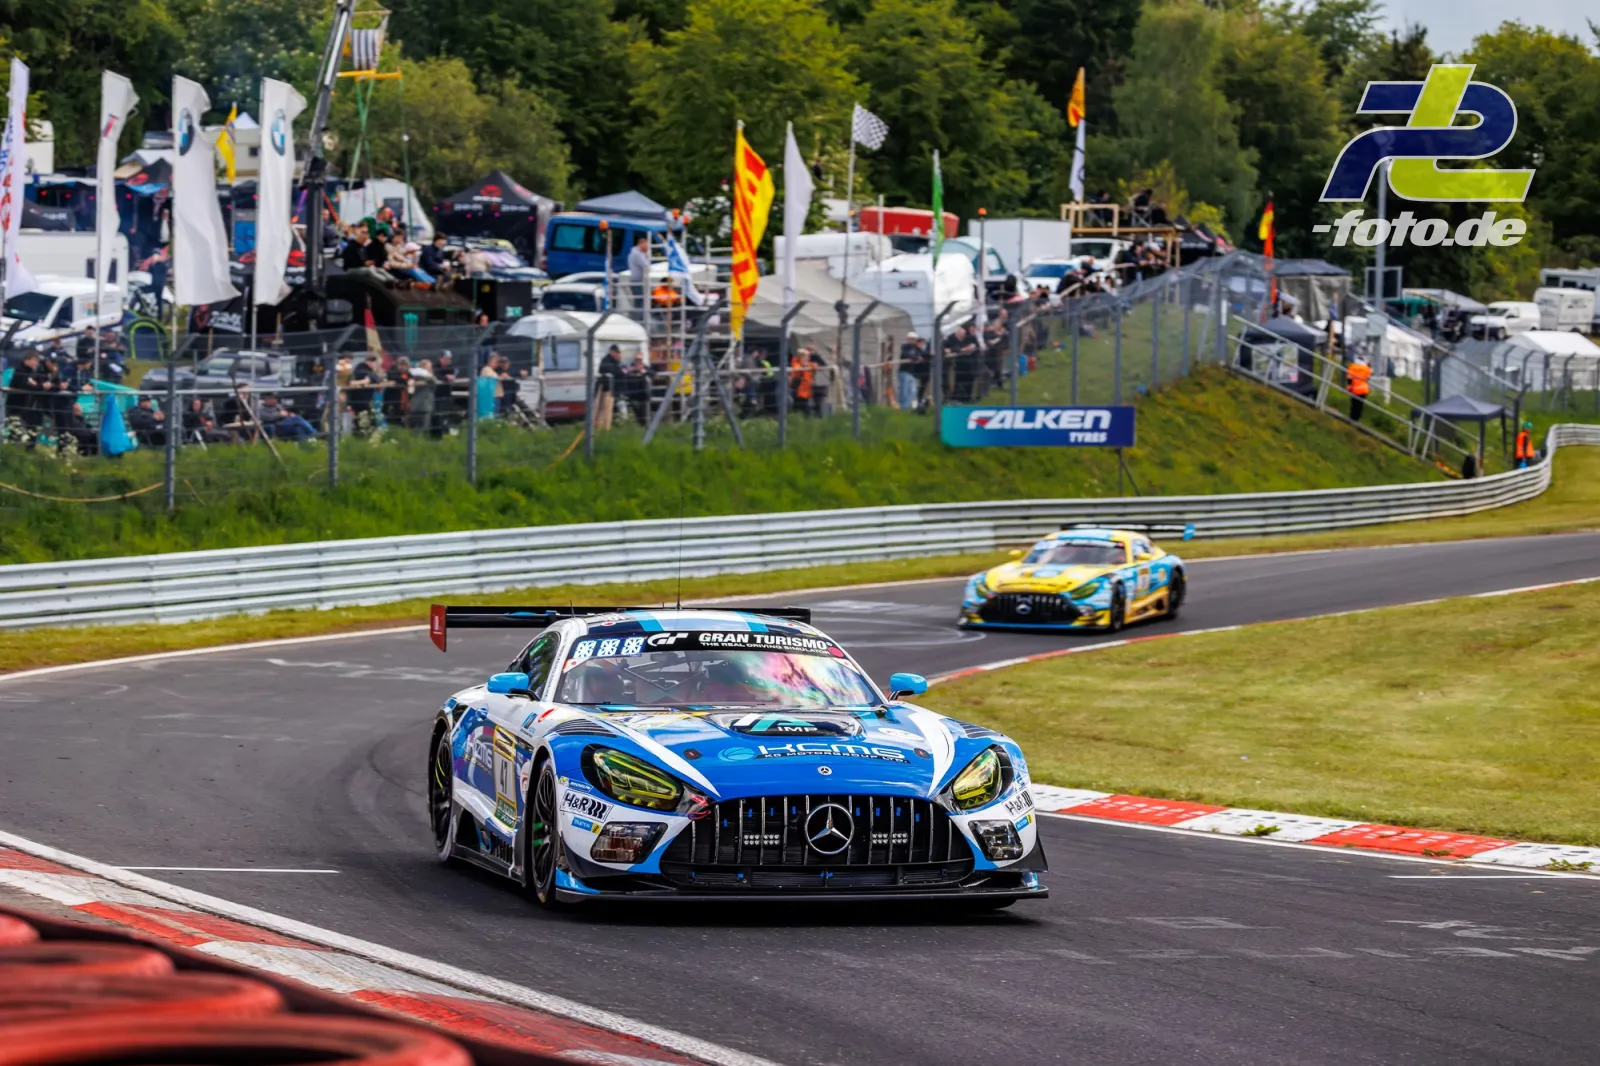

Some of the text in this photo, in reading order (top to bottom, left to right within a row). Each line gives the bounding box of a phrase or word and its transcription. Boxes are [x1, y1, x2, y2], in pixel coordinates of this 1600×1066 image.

[967, 409, 1112, 430] FALKEN
[1069, 431, 1107, 443] TYRES
[698, 632, 750, 643] GRAN
[783, 646, 830, 656] SIMULATOR
[758, 742, 906, 760] KCMG
[786, 751, 878, 759] MOTORGROUP
[563, 792, 589, 812] H&R
